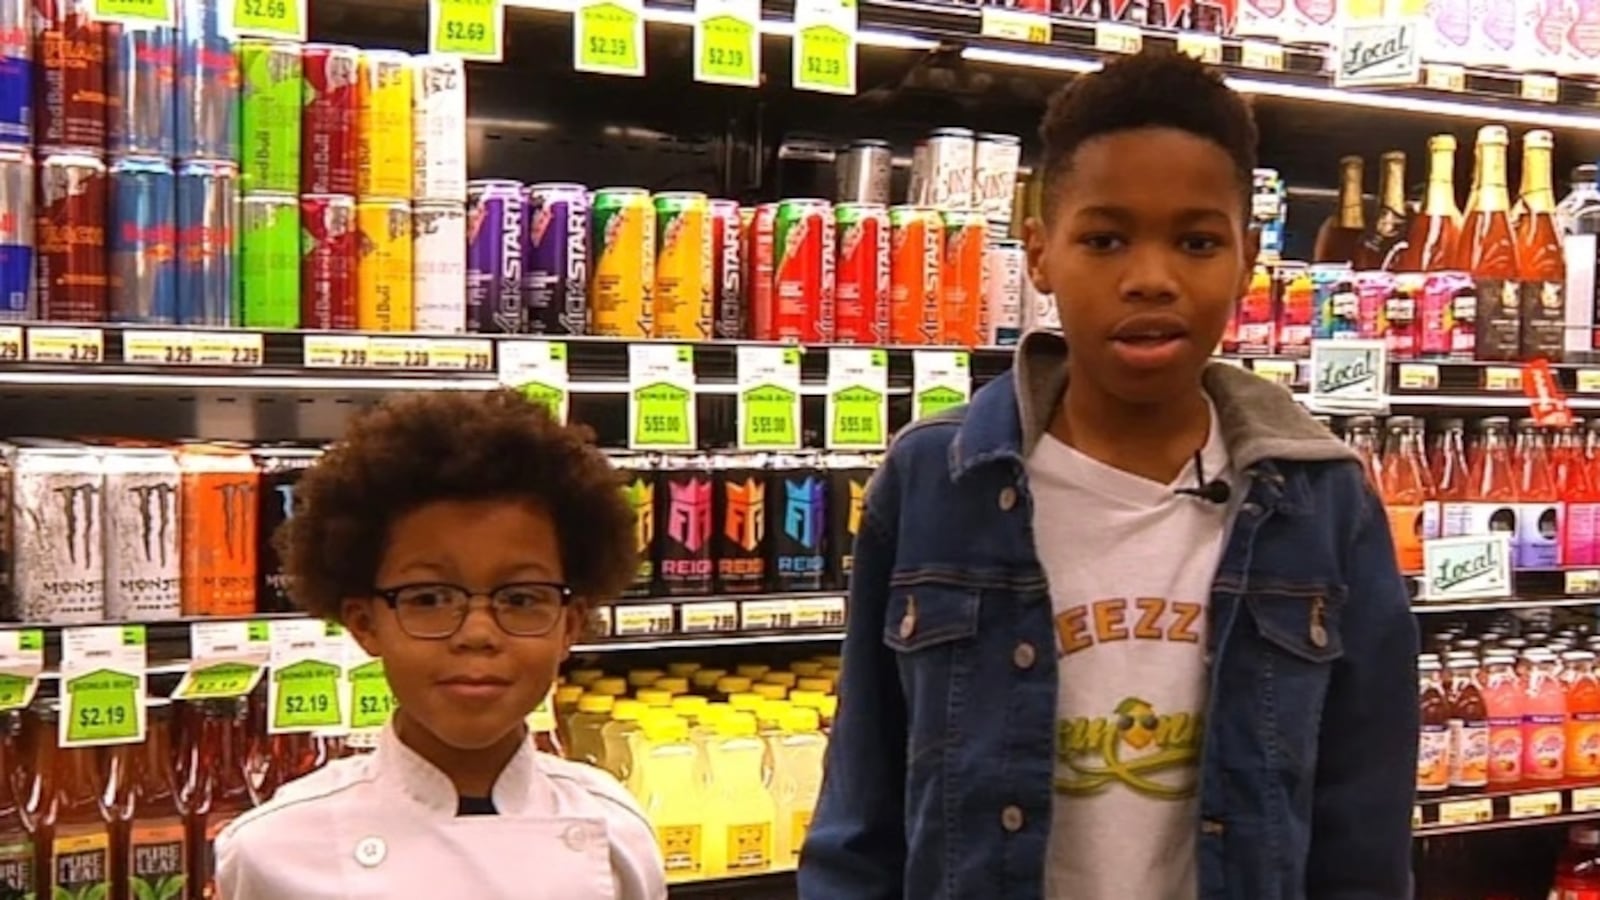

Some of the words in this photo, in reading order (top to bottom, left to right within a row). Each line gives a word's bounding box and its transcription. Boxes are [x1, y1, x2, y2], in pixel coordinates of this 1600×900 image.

[243, 0, 286, 18] $2.69
[446, 21, 485, 41] $2.69
[1343, 26, 1409, 68] Local
[1316, 350, 1376, 390] Local
[1434, 543, 1498, 587] Local
[1054, 598, 1202, 659] EEZZ
[285, 693, 328, 714] $2.19
[360, 694, 390, 714] $2.1
[79, 705, 126, 727] $2.19
[59, 852, 101, 869] PURE
[135, 845, 180, 862] PURE
[135, 860, 179, 875] LEAF
